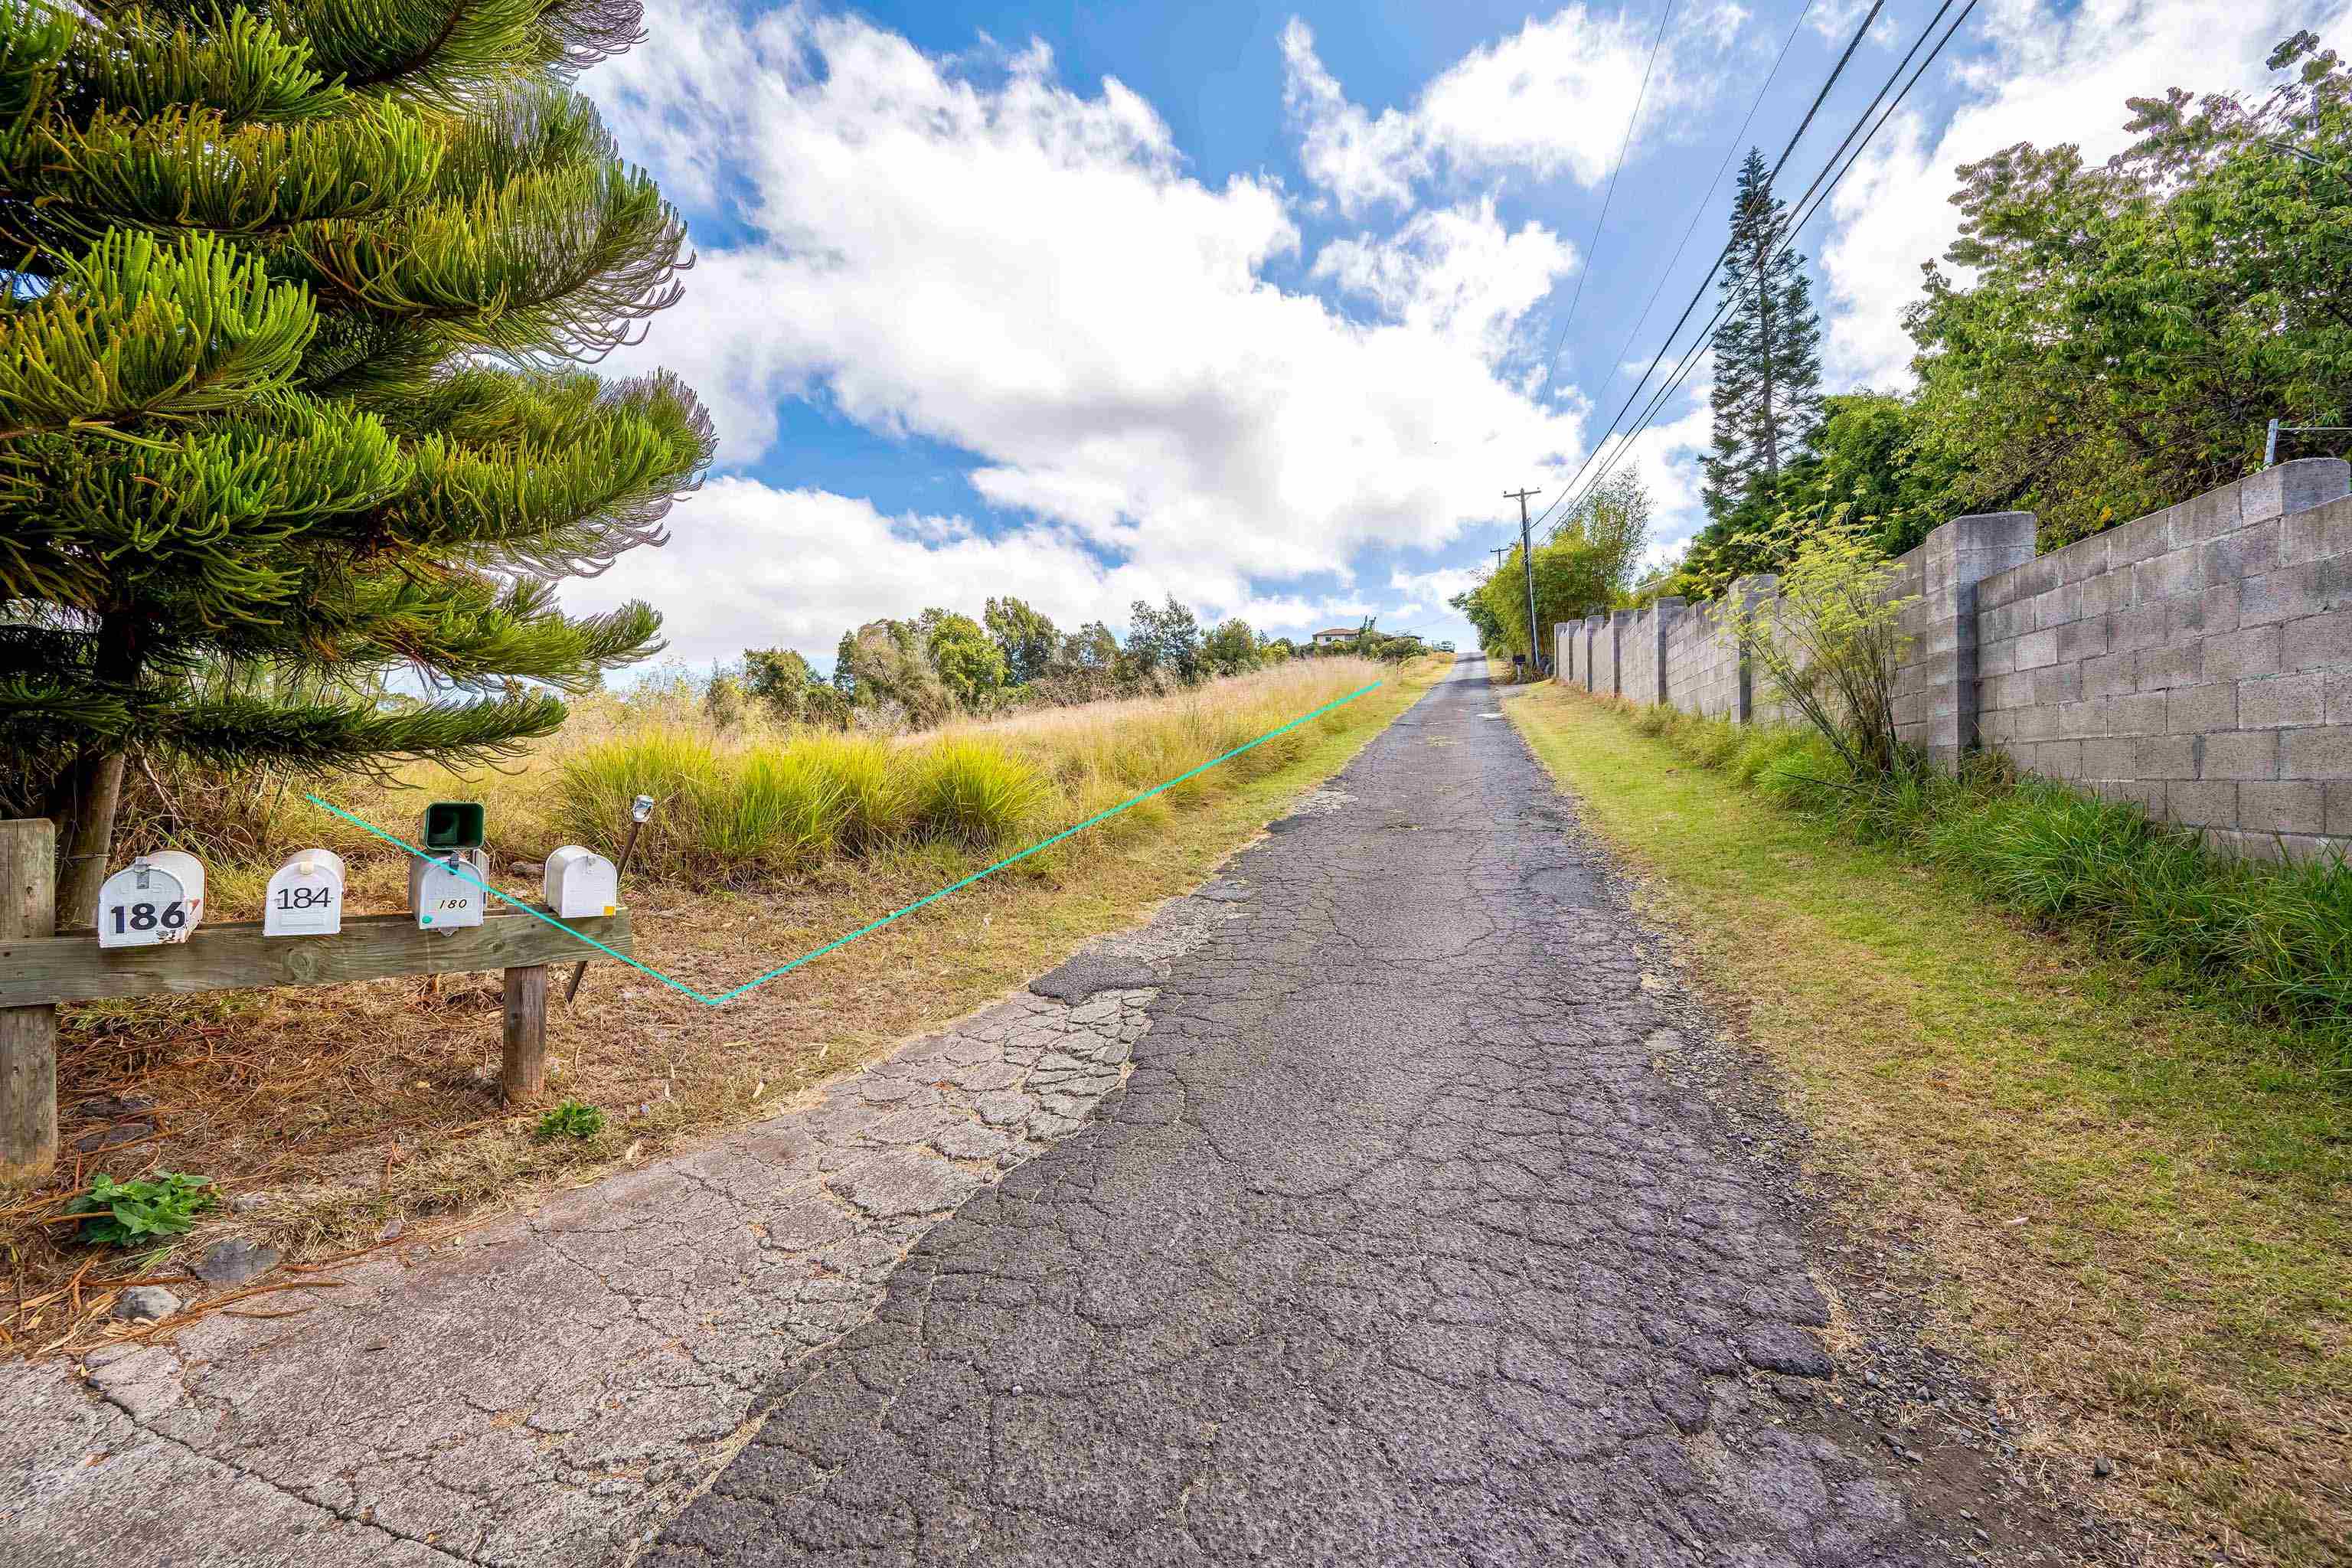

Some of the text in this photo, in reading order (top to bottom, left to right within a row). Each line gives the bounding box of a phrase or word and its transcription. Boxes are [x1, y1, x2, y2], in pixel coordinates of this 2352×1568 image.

[277, 887, 332, 910] 184
[439, 899, 467, 910] 180
[110, 901, 185, 934] 186
